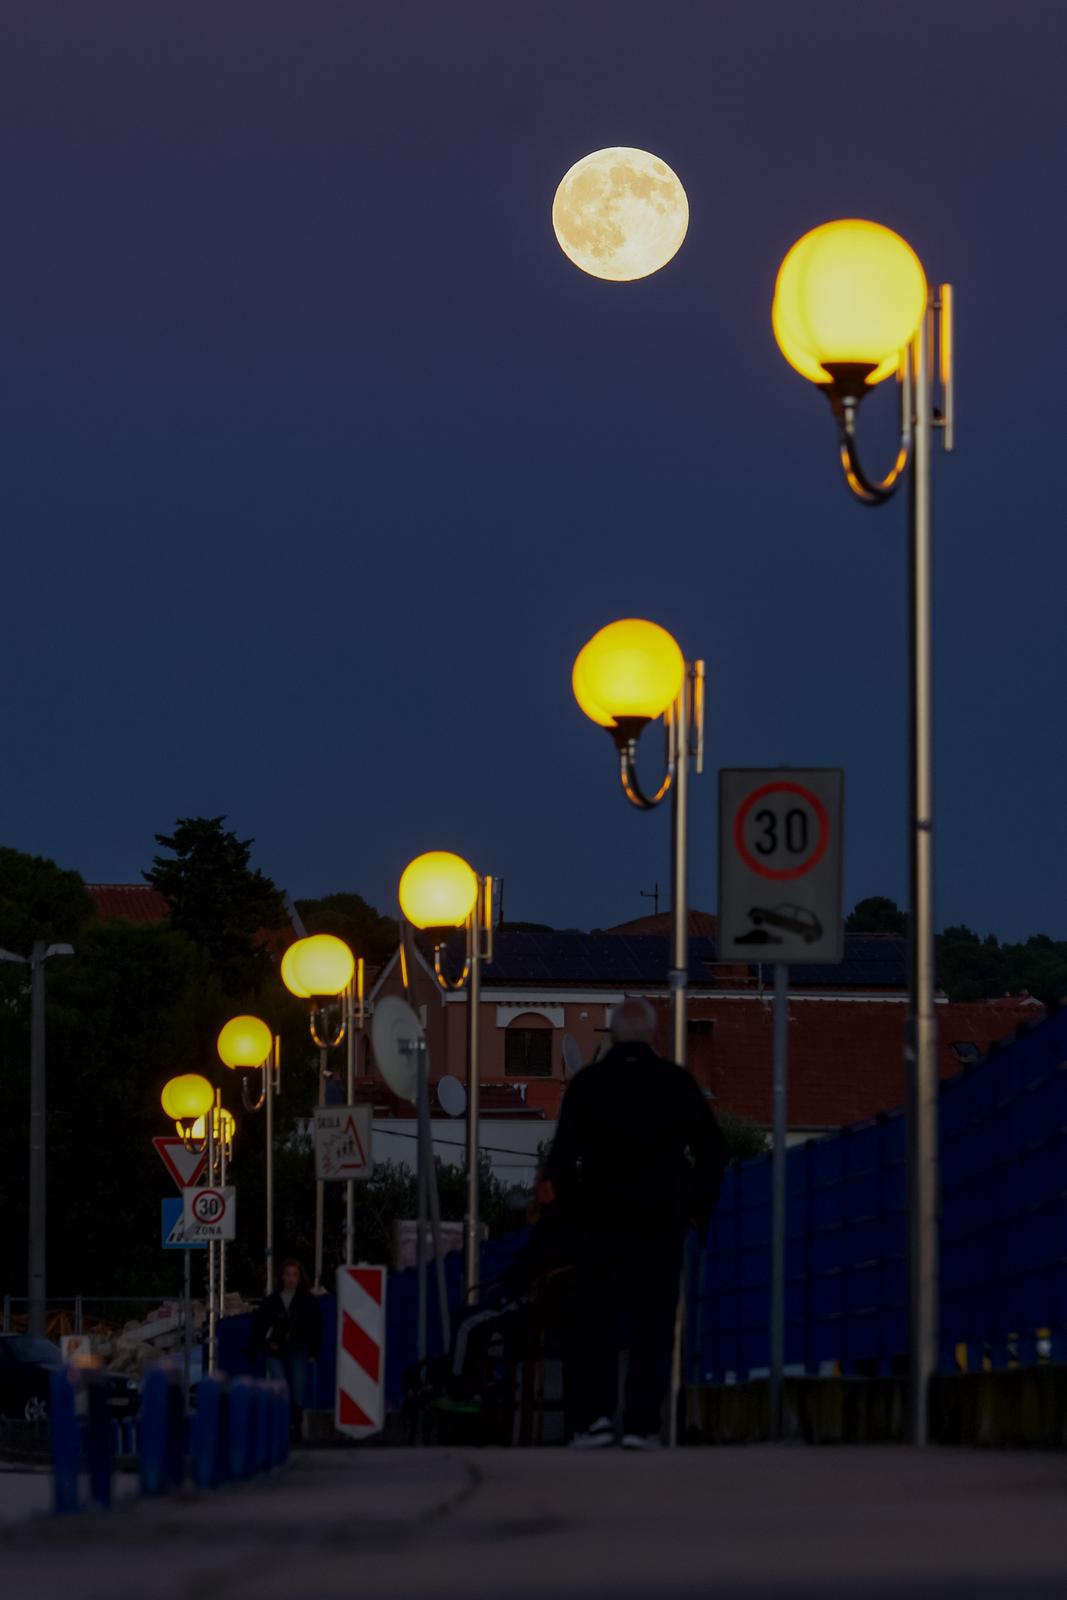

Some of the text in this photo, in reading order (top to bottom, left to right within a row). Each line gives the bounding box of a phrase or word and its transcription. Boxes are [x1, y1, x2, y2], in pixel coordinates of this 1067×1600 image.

[755, 808, 807, 855] 30
[199, 1198, 219, 1216] 30
[195, 1225, 223, 1235] ZONA
